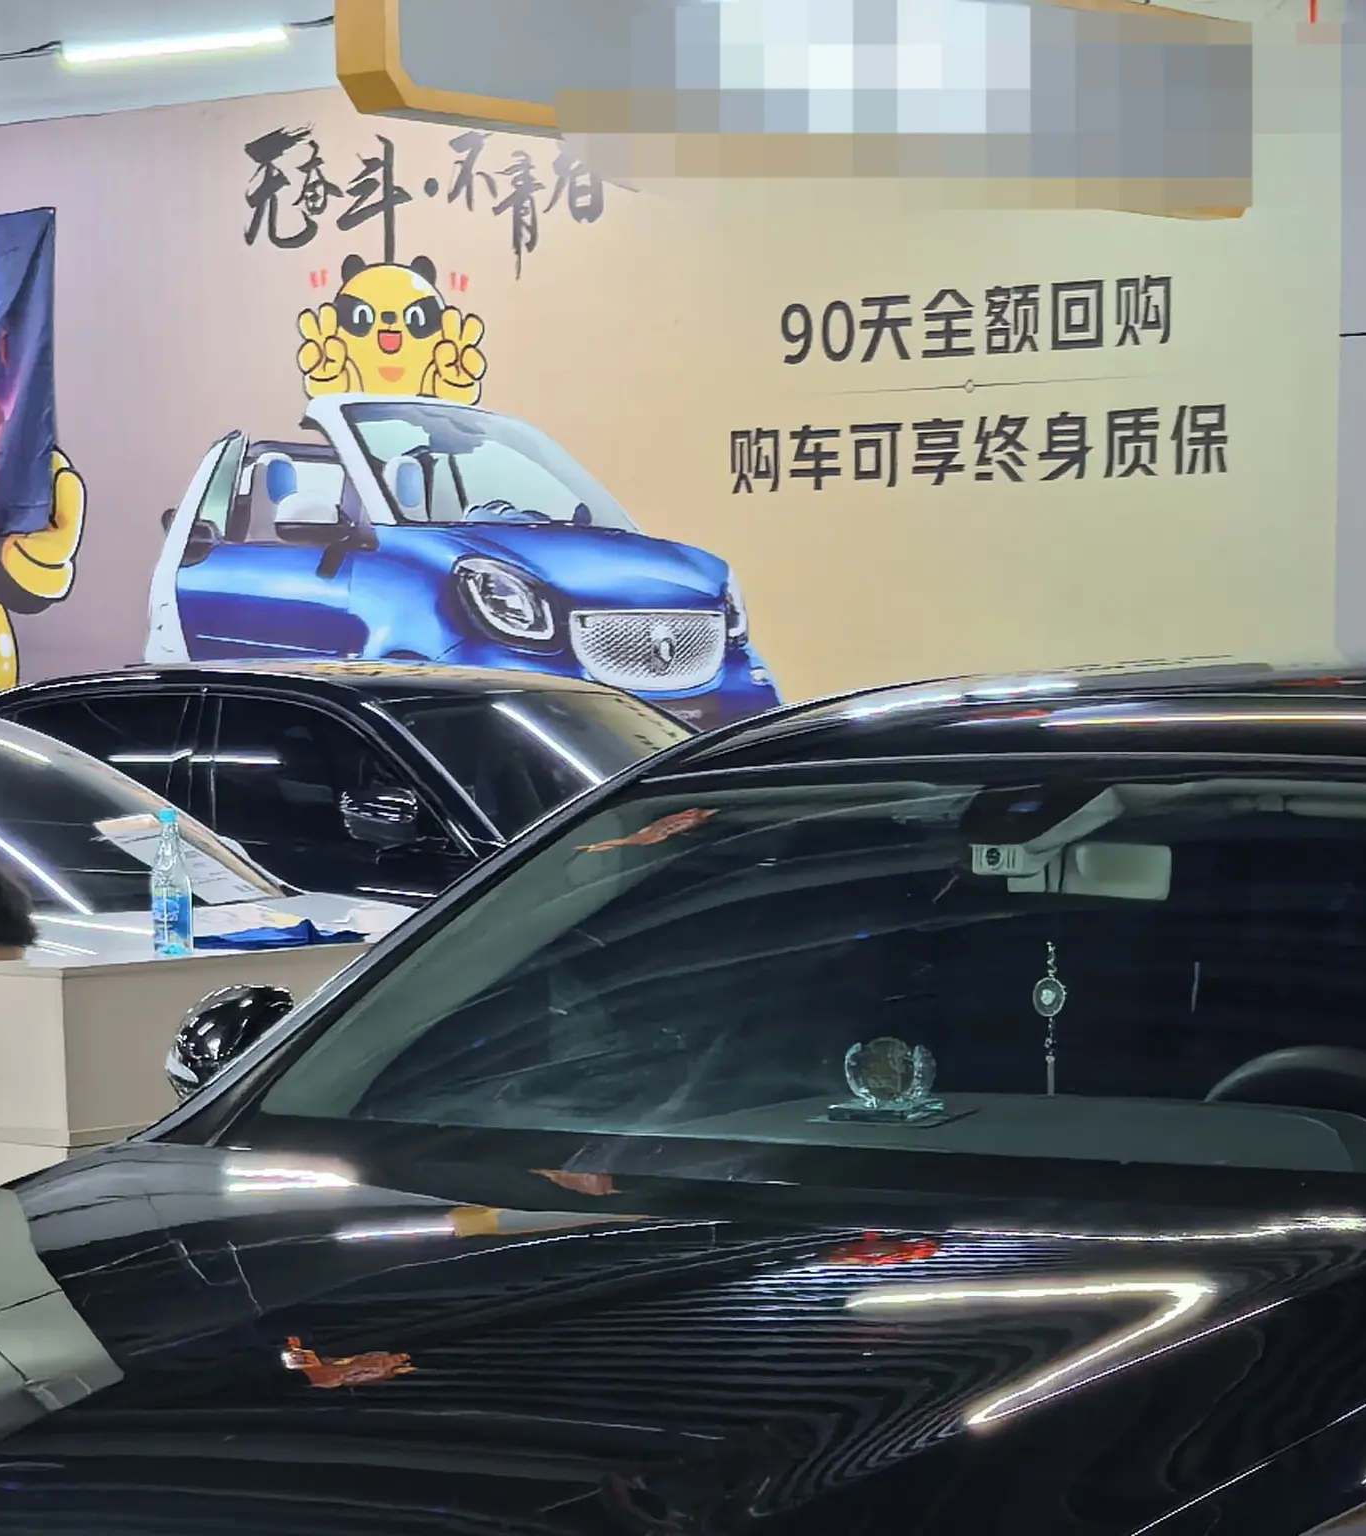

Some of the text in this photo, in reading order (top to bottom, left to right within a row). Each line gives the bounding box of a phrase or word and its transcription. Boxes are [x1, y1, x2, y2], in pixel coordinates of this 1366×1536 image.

[779, 273, 1173, 366] 90天全额回购
[729, 402, 1230, 497] 购车可享终身质保
